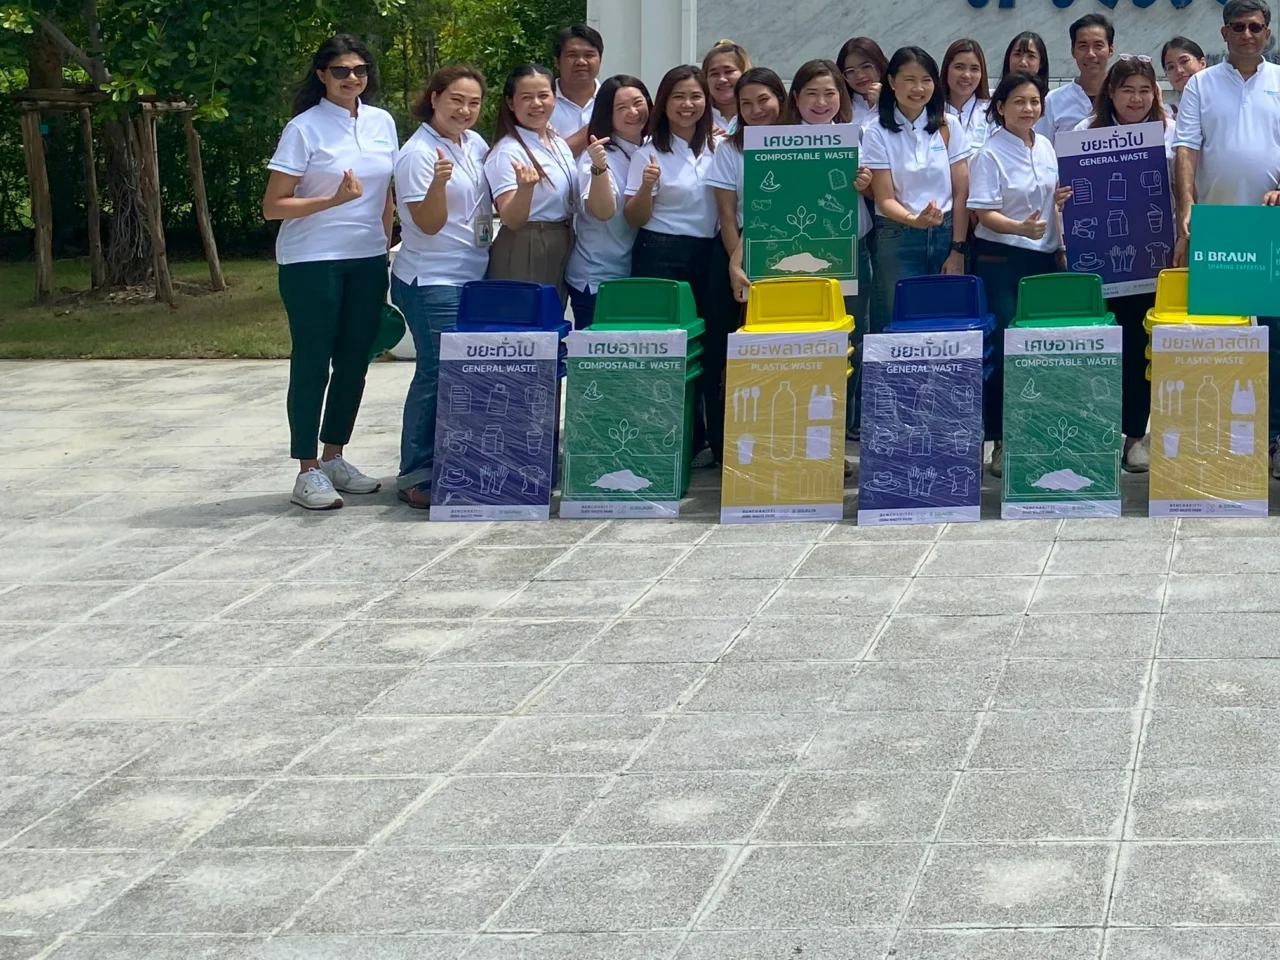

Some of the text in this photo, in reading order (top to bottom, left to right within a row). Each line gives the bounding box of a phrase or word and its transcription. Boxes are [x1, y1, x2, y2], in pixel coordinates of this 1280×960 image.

[764, 134, 842, 147] เศษอาหาร
[1081, 130, 1144, 152] ขยะทั่วไป
[754, 151, 854, 161] COMPOSTABLE WASTE
[1080, 151, 1148, 166] GENERAL WASTE
[1194, 251, 1257, 262] B BRAUN
[467, 337, 535, 357] ขยะทั่วไป
[1024, 339, 1104, 352] เศษอาหาร
[1162, 334, 1260, 349] ขยะพลาสติก
[588, 342, 668, 354] เศษอาหาร
[738, 340, 839, 356] ขยะพลาสติก
[1015, 357, 1117, 367] COMPOSTABLE WASTE
[1174, 356, 1244, 364] PLASTIC WASTE
[462, 364, 537, 373] GENERAL WASTE
[578, 362, 680, 370] COMPOSTABLE WASTE
[751, 362, 822, 371] PLASTIC WASTE
[886, 364, 962, 374] GENERAL WASTE
